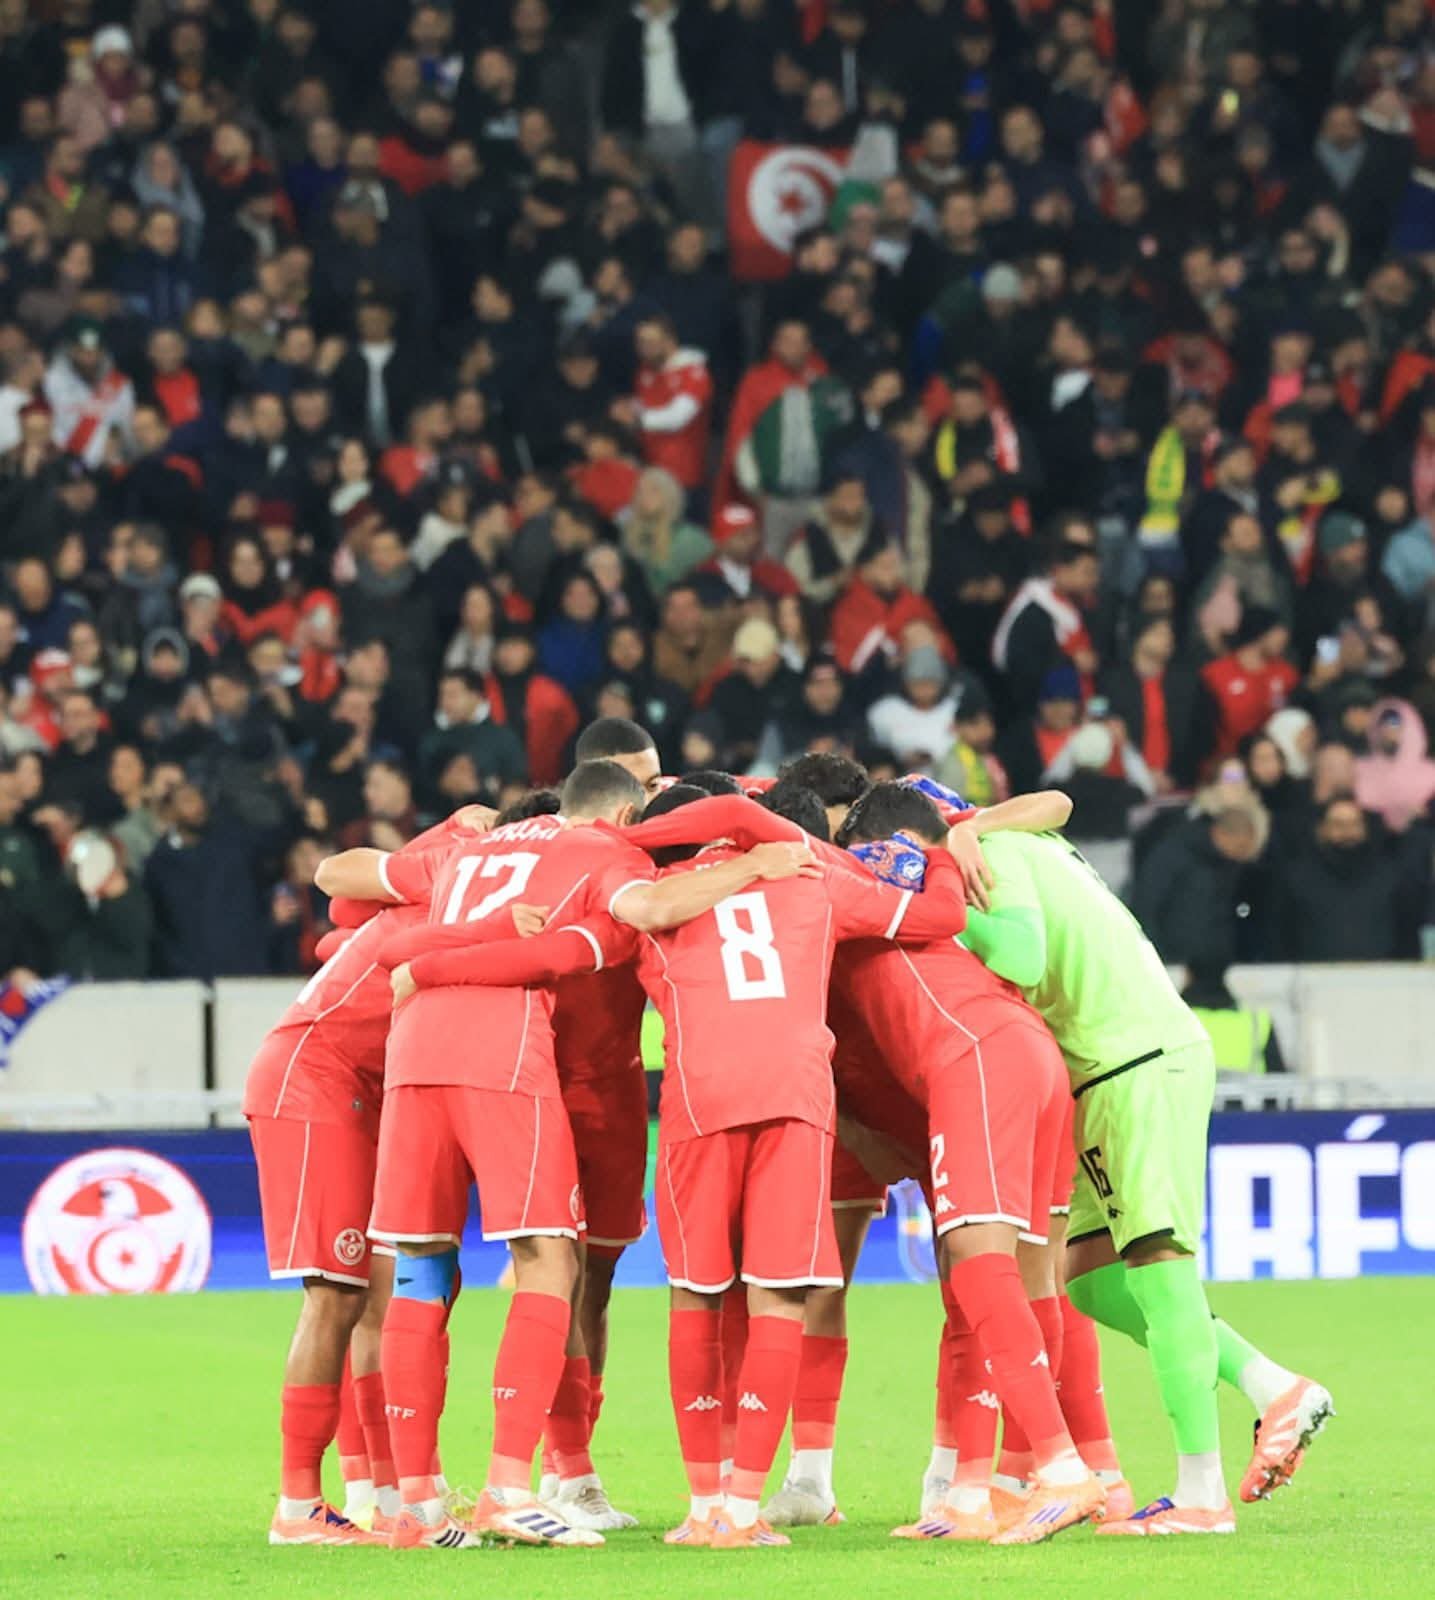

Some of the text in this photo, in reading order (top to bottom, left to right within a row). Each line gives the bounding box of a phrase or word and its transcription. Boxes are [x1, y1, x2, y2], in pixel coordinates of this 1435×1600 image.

[443, 852, 541, 925] 17
[713, 890, 787, 1001] 8
[930, 1132, 949, 1190] 2
[1080, 1145, 1114, 1201] 16
